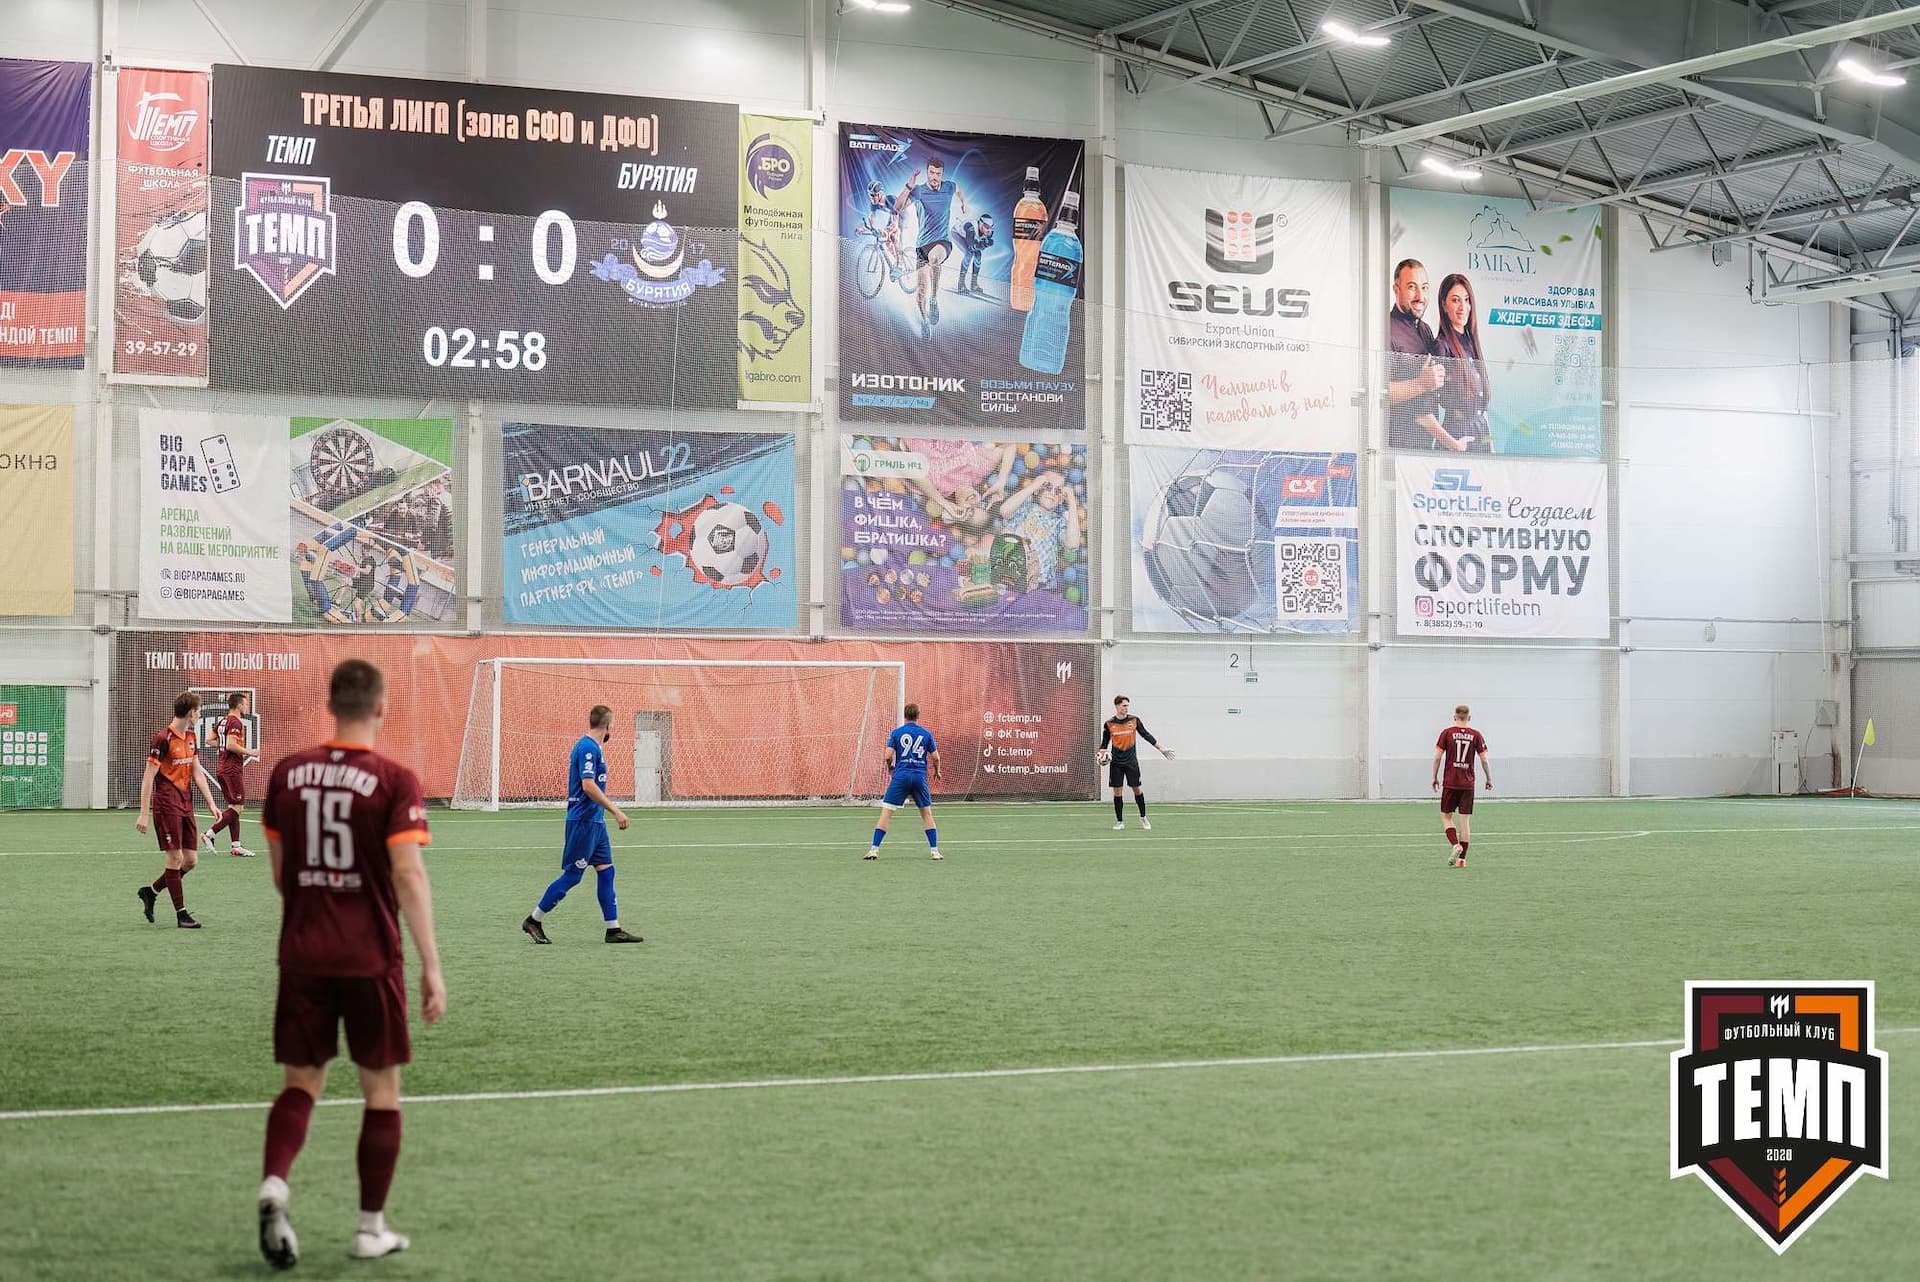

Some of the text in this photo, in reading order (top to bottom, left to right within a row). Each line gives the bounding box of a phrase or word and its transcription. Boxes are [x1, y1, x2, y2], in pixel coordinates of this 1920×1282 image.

[301, 92, 659, 156] ТРЕТЬЯ ЛИГА (зона СФО и ДФО)
[266, 135, 316, 165] ТЕМП
[128, 165, 199, 178] ФУТБОЛЬНАЯ
[617, 162, 698, 194] БУРЯТИЯ
[143, 178, 181, 188] ШКОЛА
[744, 205, 803, 218] Молодёжная
[745, 216, 803, 230] футбольная
[245, 212, 326, 260] ТЕМП
[393, 200, 440, 278] 0
[532, 209, 577, 285] 0
[625, 278, 691, 298] БУРЯТИЯ
[1547, 286, 1595, 297] ЗДОРОВАЯ
[1168, 281, 1311, 319] SEUS
[1504, 296, 1595, 309] И КРАСИВАЯ УЛЫБКА
[1497, 311, 1595, 328] ЖДЕТ ТЕБЯ ЗДЕСЬ!
[40, 326, 78, 345] ТЕМП!
[1206, 322, 1275, 338] Export-Union
[125, 341, 198, 356] 39-57-29
[423, 326, 547, 372] 02:58
[1168, 336, 1222, 348] СИБИРСКИЙ
[1224, 339, 1284, 352] ЭКСПОРТНЫЙ
[851, 373, 966, 393] ИЗОТОНИК
[981, 379, 1033, 391] ВОЗЬМИ
[981, 391, 1064, 403] ВОССТАНОВИ
[1280, 400, 1300, 420] из
[1304, 385, 1336, 411] нас!
[981, 402, 1020, 413] СИЛЫ.
[160, 434, 183, 452] BIG
[160, 454, 196, 473] PAPA
[874, 460, 905, 469] ГРИЛЬ
[160, 473, 208, 493] GAMES
[1432, 468, 1483, 492] SL
[524, 496, 571, 511] ИНТЕРНЕТ
[578, 482, 640, 502] СООБЩЕСТВО
[854, 493, 903, 511] В ЧЁМ
[1412, 493, 1502, 513] SportLife
[160, 507, 200, 523] АРЕНДА
[1508, 496, 1598, 526] Создаем
[854, 514, 922, 531] ФИШКА,
[160, 524, 232, 541] РАЗВЛЕЧЕНИЙ
[854, 531, 947, 547] БРАТИШКА?
[1414, 524, 1592, 551] СПОРТИВНУЮ
[160, 541, 280, 560] НА ВАШЕ МЕРОПРИЯТИЕ
[521, 526, 605, 559] ГЕНЕРАЛЬНЫЙ
[521, 545, 636, 584] ИНФОРМАЦИОННЫЙ
[173, 569, 246, 583] BIGPAPAGAMES.RU
[1414, 551, 1591, 597] ФОРМУ
[174, 587, 245, 601] @BIGPAPAGAMES
[520, 569, 644, 608] ПАРТНЕР ФК «ТЕМП»
[1436, 598, 1541, 619] sportlifebrn
[144, 652, 300, 671] ТЕМП, ТЕМП, ТОЛЬКО ТЕМП!
[1230, 653, 1239, 668] 2
[998, 712, 1042, 724] fctemp.ru
[997, 729, 1039, 739] ФК Темп
[900, 733, 925, 759] 94
[997, 746, 1033, 758] fc.temp
[1455, 739, 1470, 763] 17
[998, 763, 1068, 776] fctemp_barnaul
[301, 788, 354, 870] 15
[298, 870, 362, 888] SEUS
